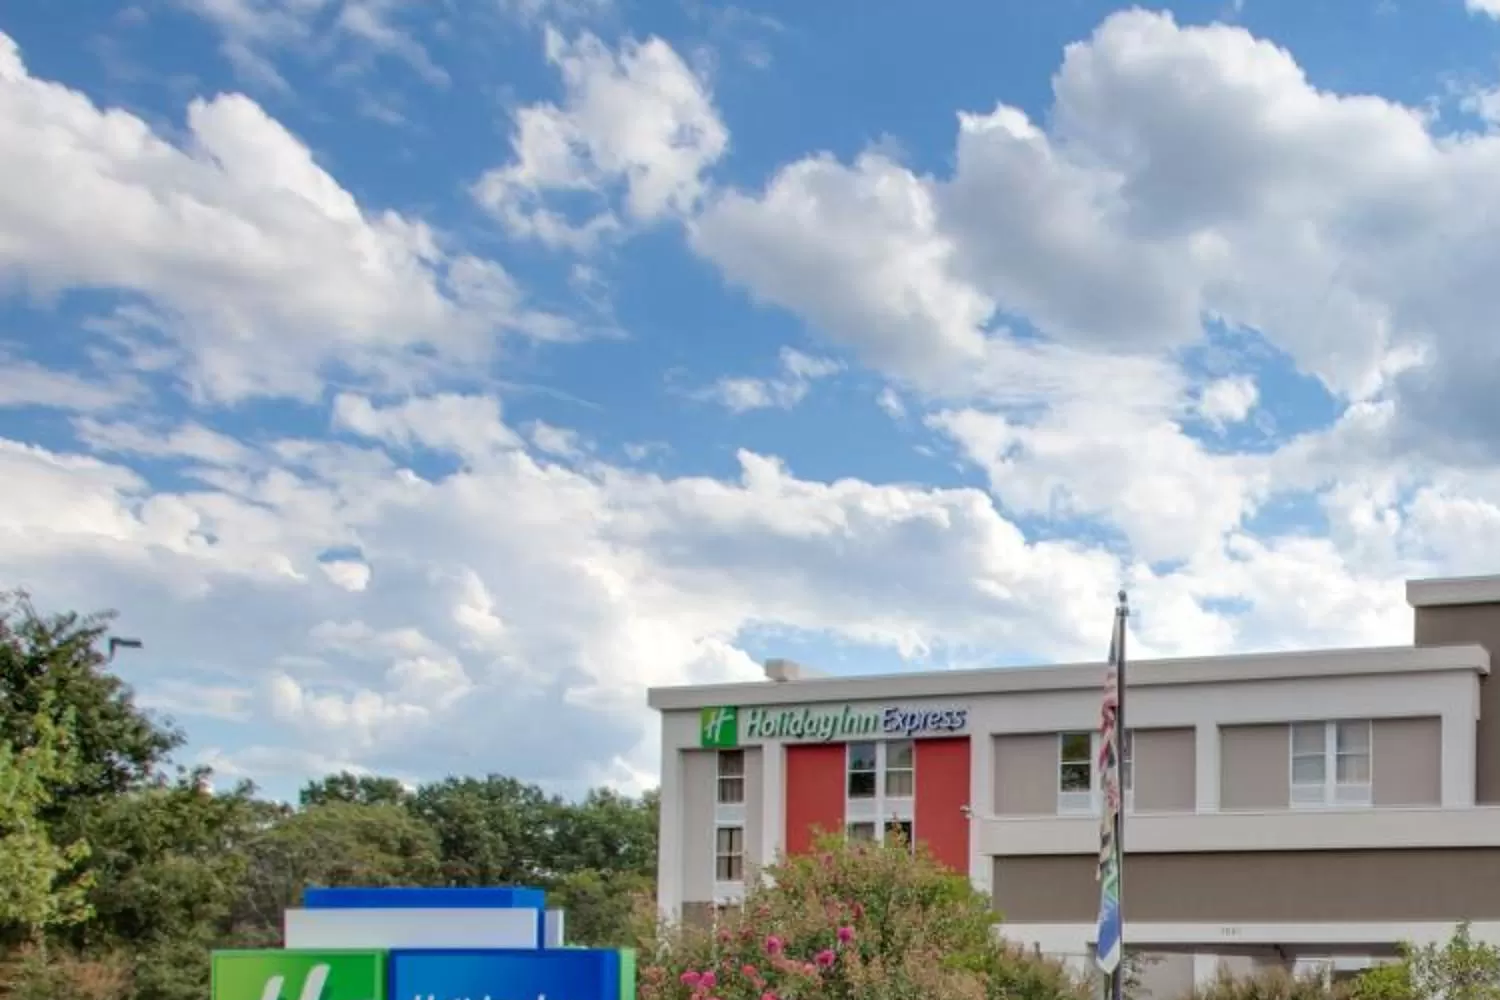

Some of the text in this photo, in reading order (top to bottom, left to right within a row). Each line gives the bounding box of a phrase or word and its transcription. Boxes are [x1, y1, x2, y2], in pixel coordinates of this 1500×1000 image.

[747, 704, 967, 741] Holiday Inn Express
